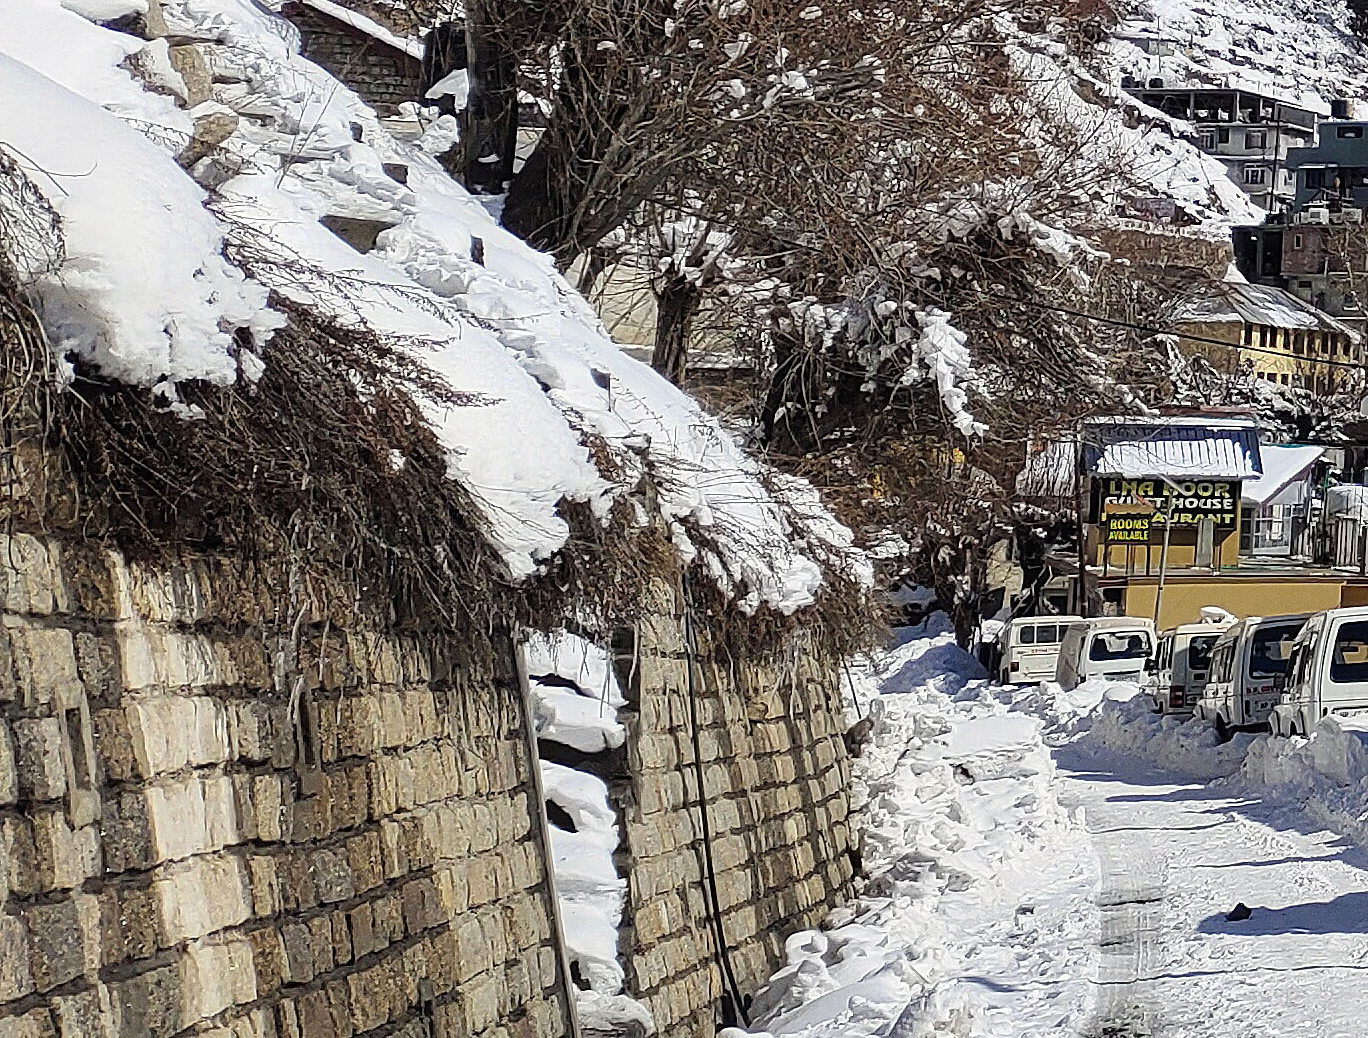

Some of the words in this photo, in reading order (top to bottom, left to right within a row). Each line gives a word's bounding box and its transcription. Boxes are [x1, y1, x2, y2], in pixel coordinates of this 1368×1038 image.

[1172, 498, 1233, 510] HOUSE
[1110, 519, 1149, 530] ROOMS
[1108, 531, 1149, 541] AVAILABLE
